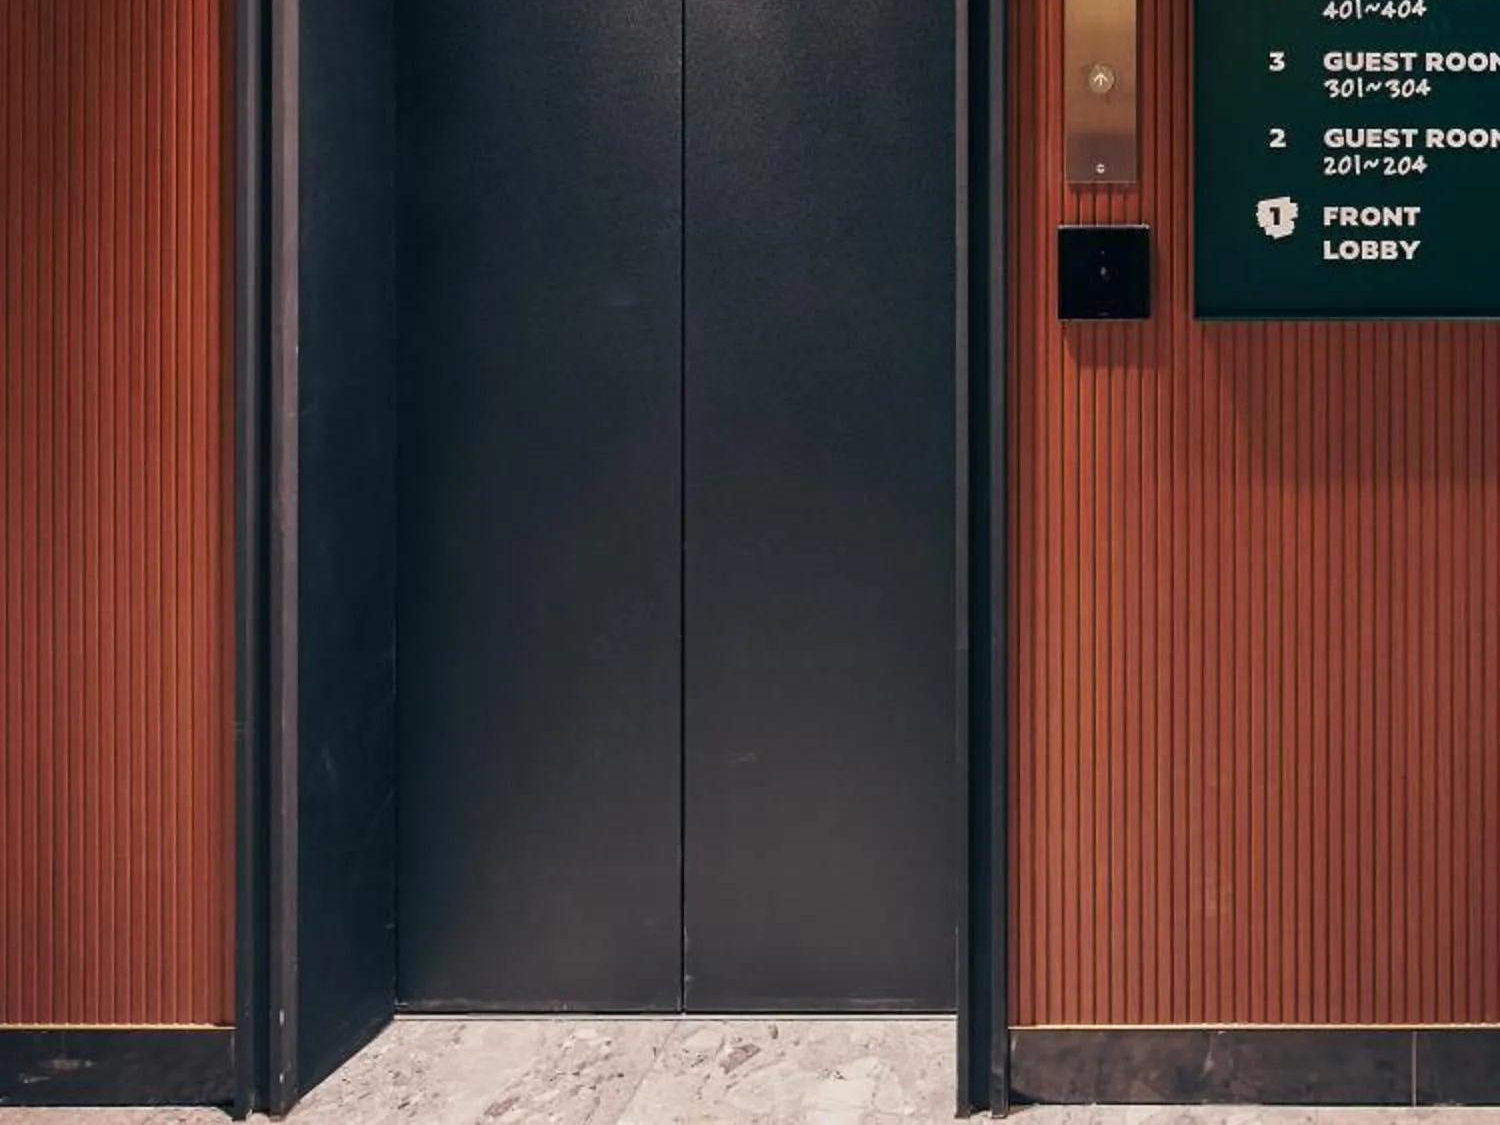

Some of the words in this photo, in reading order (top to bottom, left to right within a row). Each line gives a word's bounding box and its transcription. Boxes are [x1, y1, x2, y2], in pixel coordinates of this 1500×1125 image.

[1269, 51, 1285, 72] 3
[1323, 51, 1418, 72] GUEST
[1269, 128, 1287, 148] 2
[1323, 128, 1419, 148] GUEST
[1268, 206, 1283, 226] 1
[1323, 206, 1421, 227] FRONT
[1323, 240, 1421, 260] LOBBY
